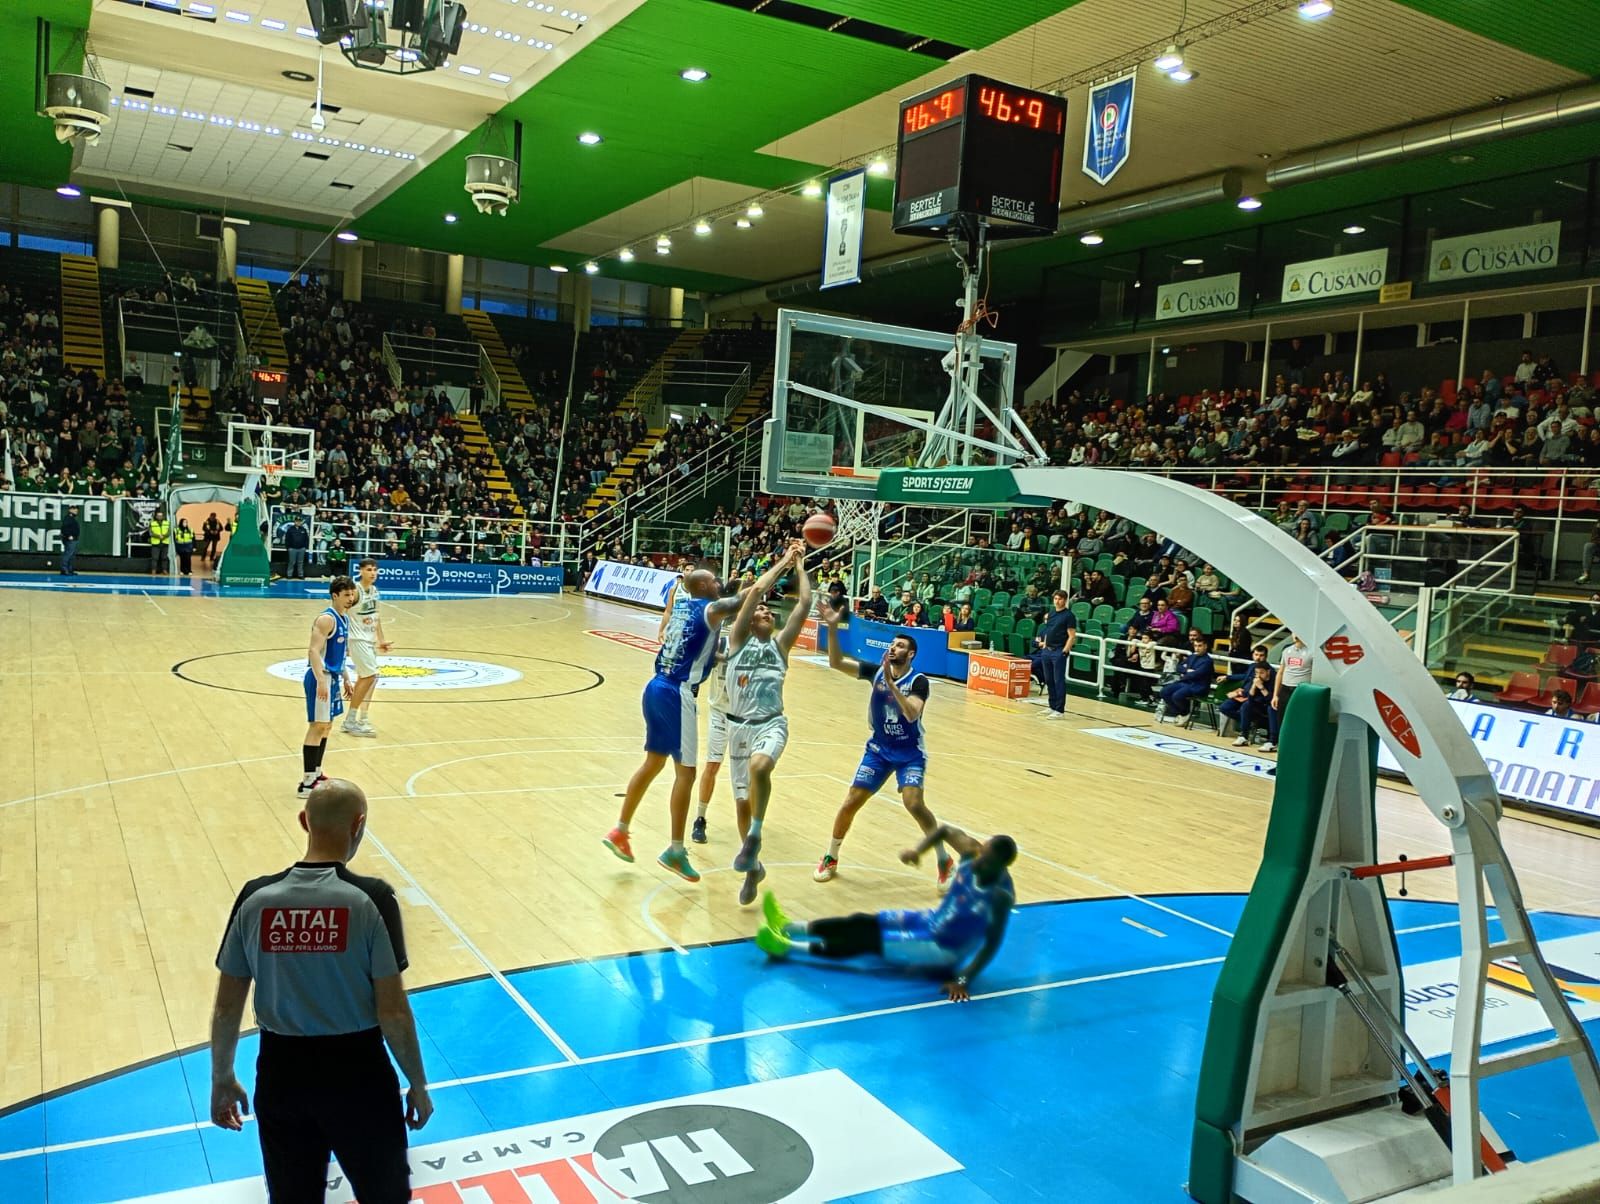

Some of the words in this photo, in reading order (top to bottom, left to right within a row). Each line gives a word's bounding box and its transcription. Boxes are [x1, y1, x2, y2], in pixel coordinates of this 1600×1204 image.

[1461, 246, 1554, 273] CUSANO
[1308, 269, 1382, 295] CUSANO
[1177, 291, 1236, 313] CUSANO
[442, 570, 475, 579] BONO
[612, 565, 658, 583] MATRIX
[980, 666, 1009, 680] DURING
[1382, 704, 1415, 745] ACE
[269, 909, 339, 930] ATTAL
[269, 931, 338, 944] GROUP
[326, 1131, 587, 1191] CAMPAA
